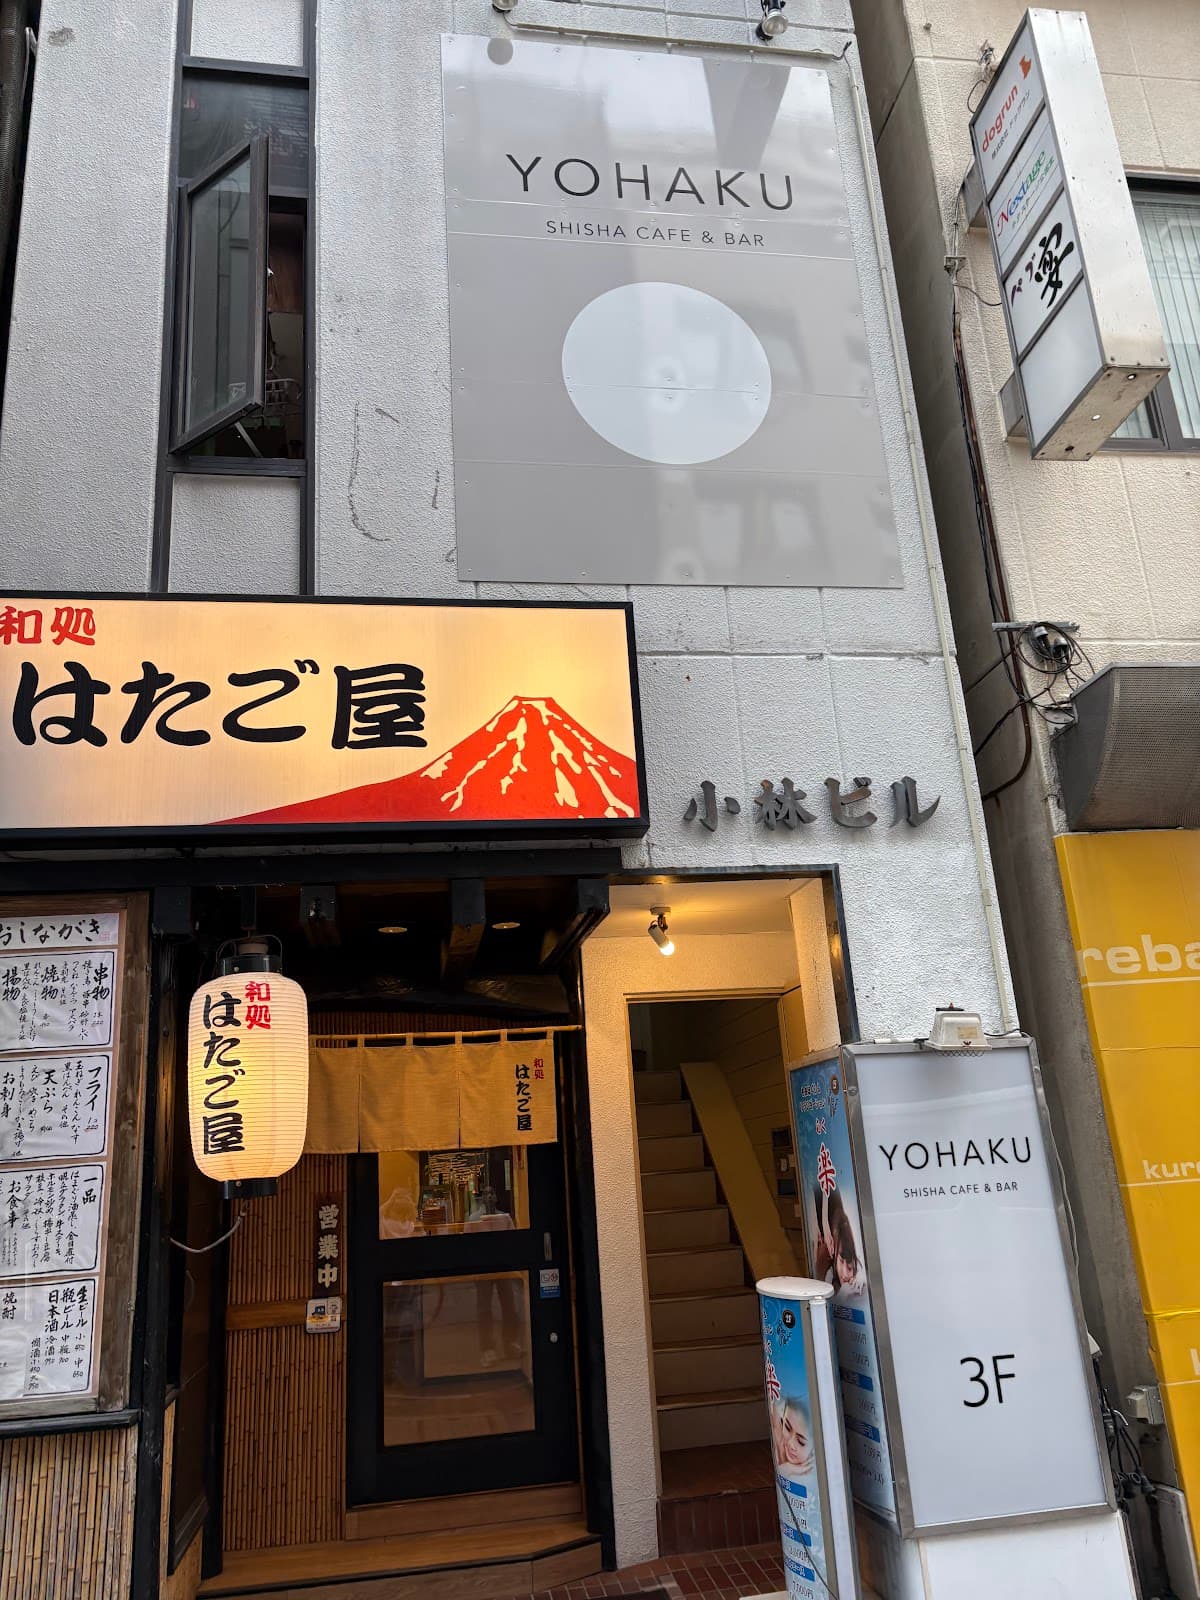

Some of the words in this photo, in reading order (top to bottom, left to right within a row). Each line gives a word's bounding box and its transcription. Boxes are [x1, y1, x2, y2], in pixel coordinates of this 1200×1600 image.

[982, 85, 1018, 152] dogrun
[505, 153, 793, 211] YOHAKU
[997, 151, 1046, 237] Nextage
[546, 220, 626, 238] SHISHA
[636, 226, 692, 242] CAFE
[702, 230, 714, 243] &
[724, 232, 765, 247] BAR
[0, 606, 97, 647] 和処
[12, 659, 428, 751] はたご屋
[683, 776, 941, 832] 小林ビル
[1, 966, 21, 1000] 揚物
[41, 964, 60, 1000] 焼物
[90, 963, 110, 1000] 串物
[245, 980, 271, 1030] 和処
[85, 1066, 101, 1111] フライ
[203, 991, 245, 1155] はたご屋
[533, 1057, 544, 1080] 和処
[515, 1063, 533, 1131] はたご屋
[879, 1136, 1032, 1171] YOHAKU
[1142, 1159, 1200, 1179] kur
[82, 1177, 98, 1205] 一品
[903, 1186, 946, 1198] SHISHA
[950, 1183, 979, 1195] CAFE
[984, 1182, 991, 1193] &
[996, 1181, 1018, 1192] BAR
[317, 1204, 340, 1288] 営業中
[1, 1292, 17, 1320] 焼酎
[44, 1289, 60, 1333] 日本酒
[60, 1287, 76, 1330] 瓶ビール
[76, 1285, 88, 1328] 生ビール
[960, 1354, 1016, 1408] 3F
